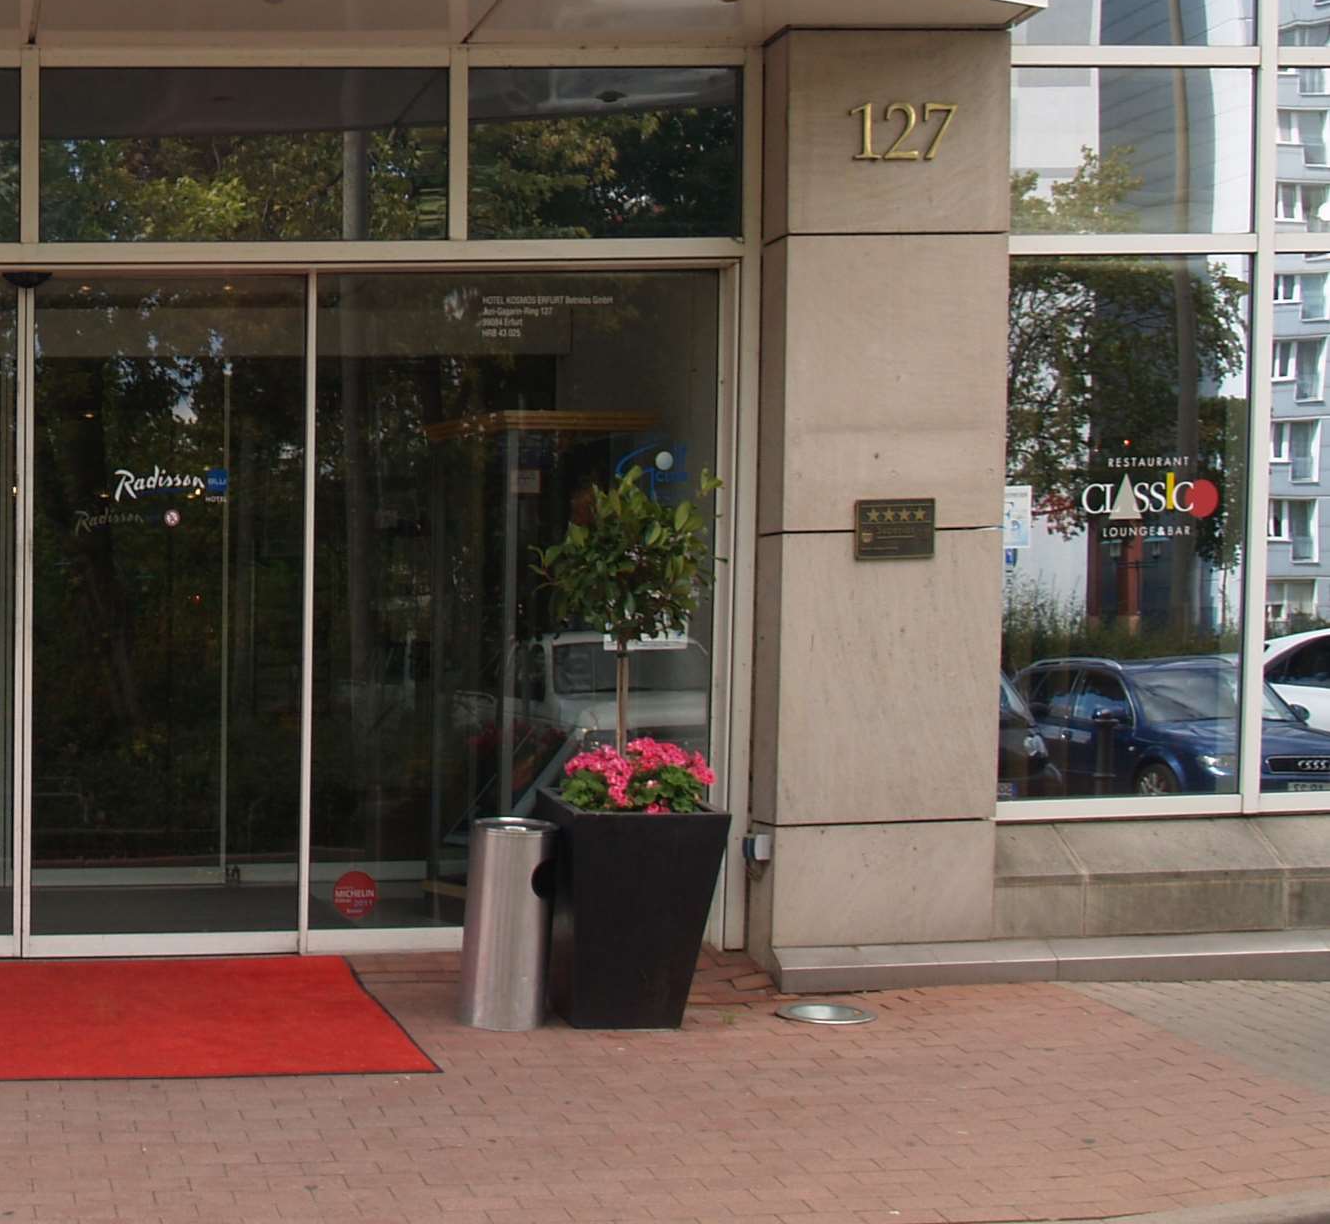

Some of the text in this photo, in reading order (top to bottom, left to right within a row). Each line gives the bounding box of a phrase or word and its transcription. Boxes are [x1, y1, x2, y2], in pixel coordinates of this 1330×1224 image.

[848, 102, 958, 160] 127
[1108, 456, 1189, 468] RESTAURANT
[114, 464, 206, 503] Radisson
[205, 494, 228, 503] HOTEL
[1102, 525, 1191, 538] LOUNGE&BAR
